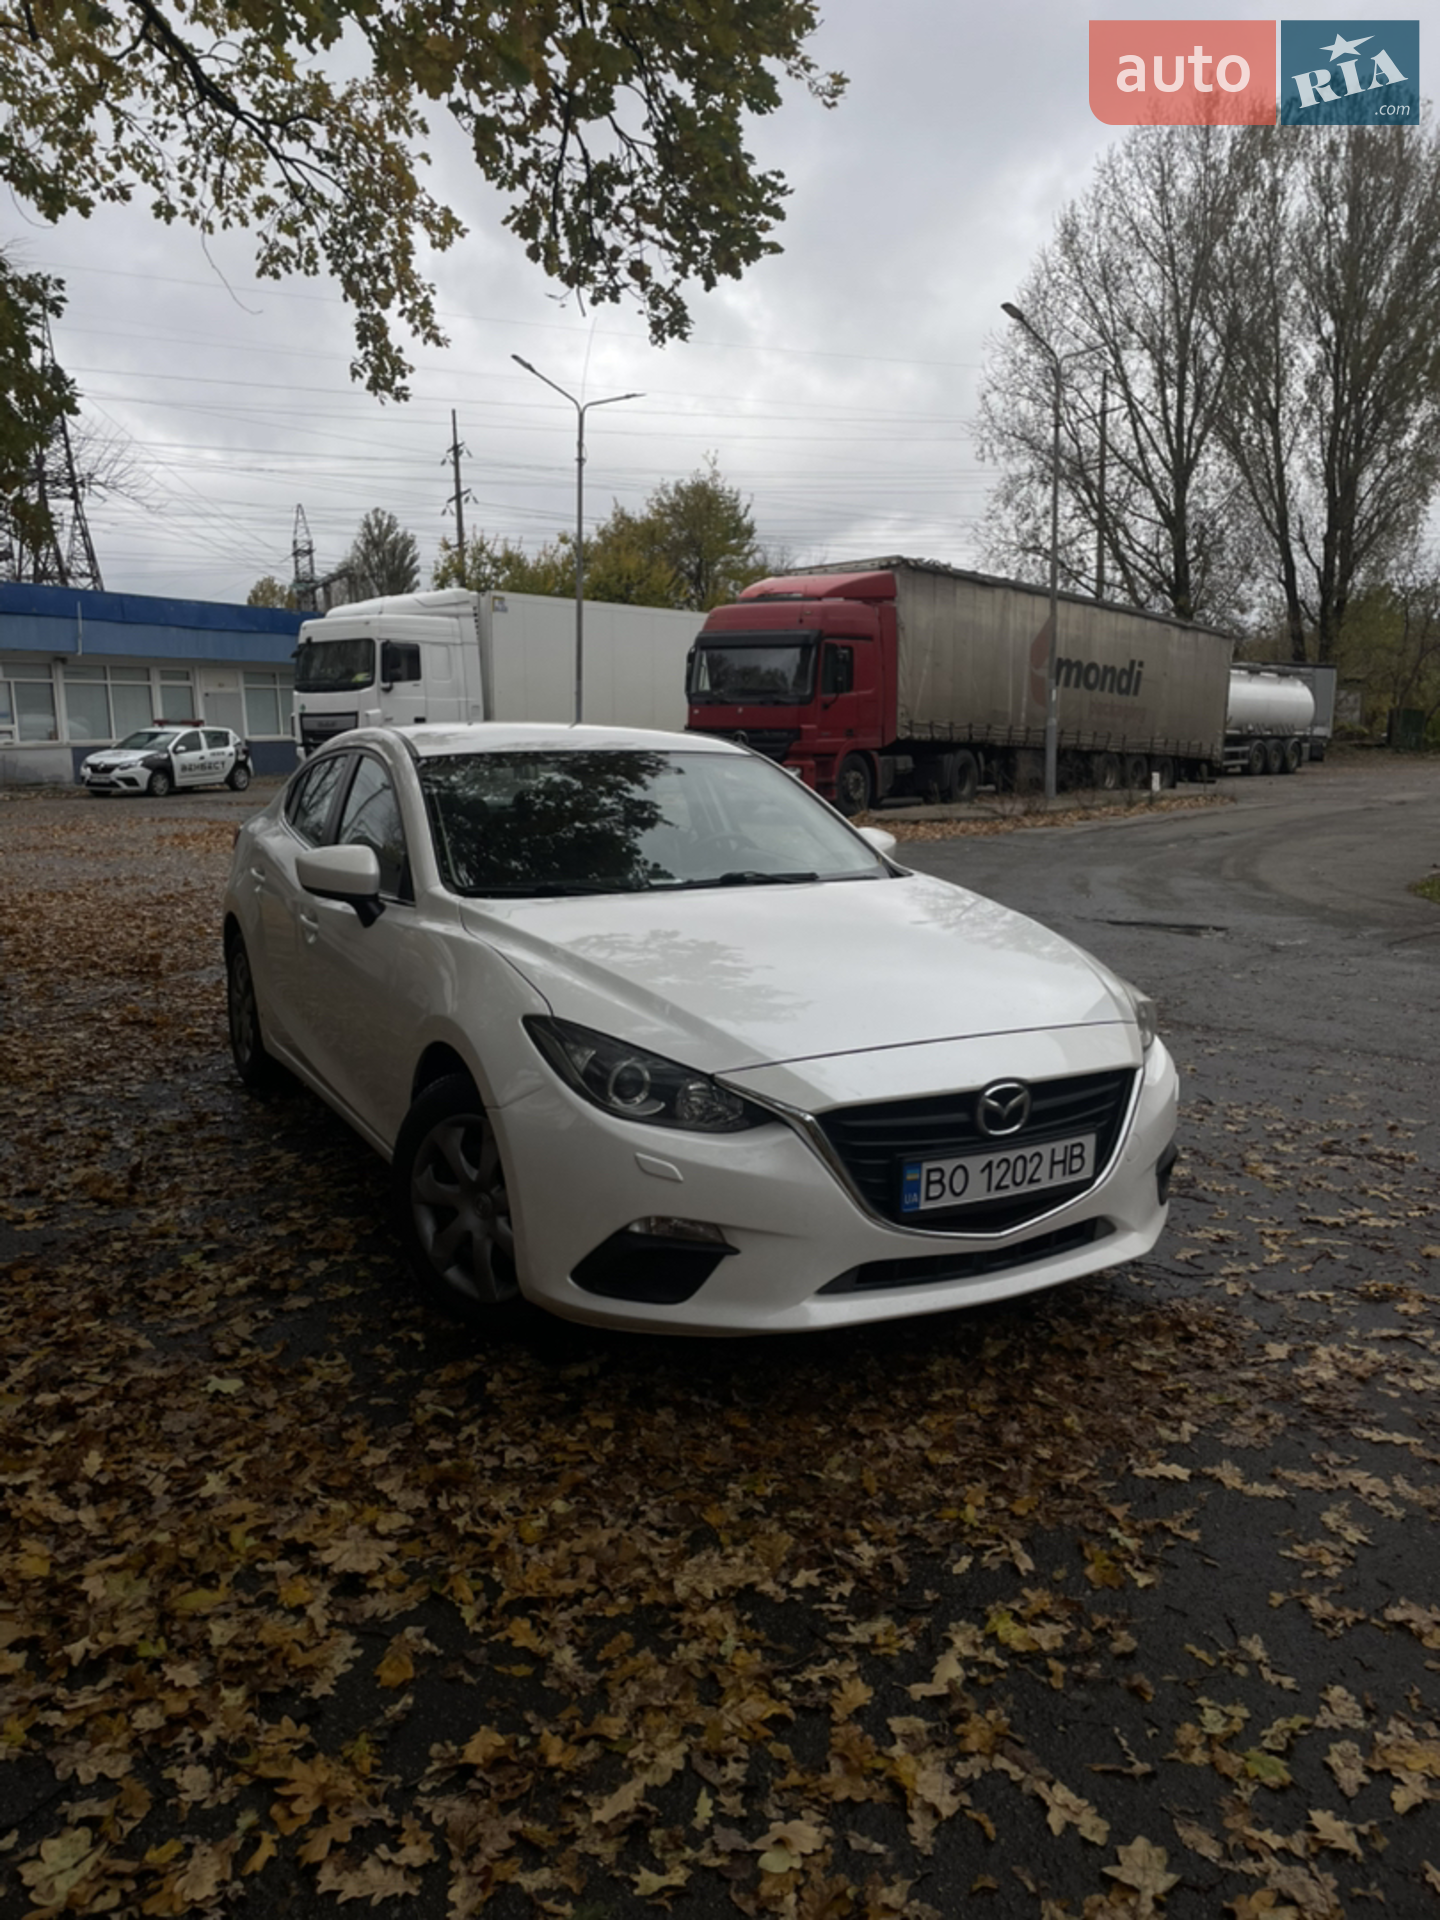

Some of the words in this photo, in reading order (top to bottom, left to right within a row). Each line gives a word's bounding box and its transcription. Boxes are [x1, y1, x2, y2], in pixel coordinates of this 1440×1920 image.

[1055, 657, 1144, 697] mondi
[924, 1164, 969, 1201] BO
[980, 1151, 1043, 1193] 1202
[1049, 1141, 1086, 1180] HB
[904, 1192, 919, 1205] UA
